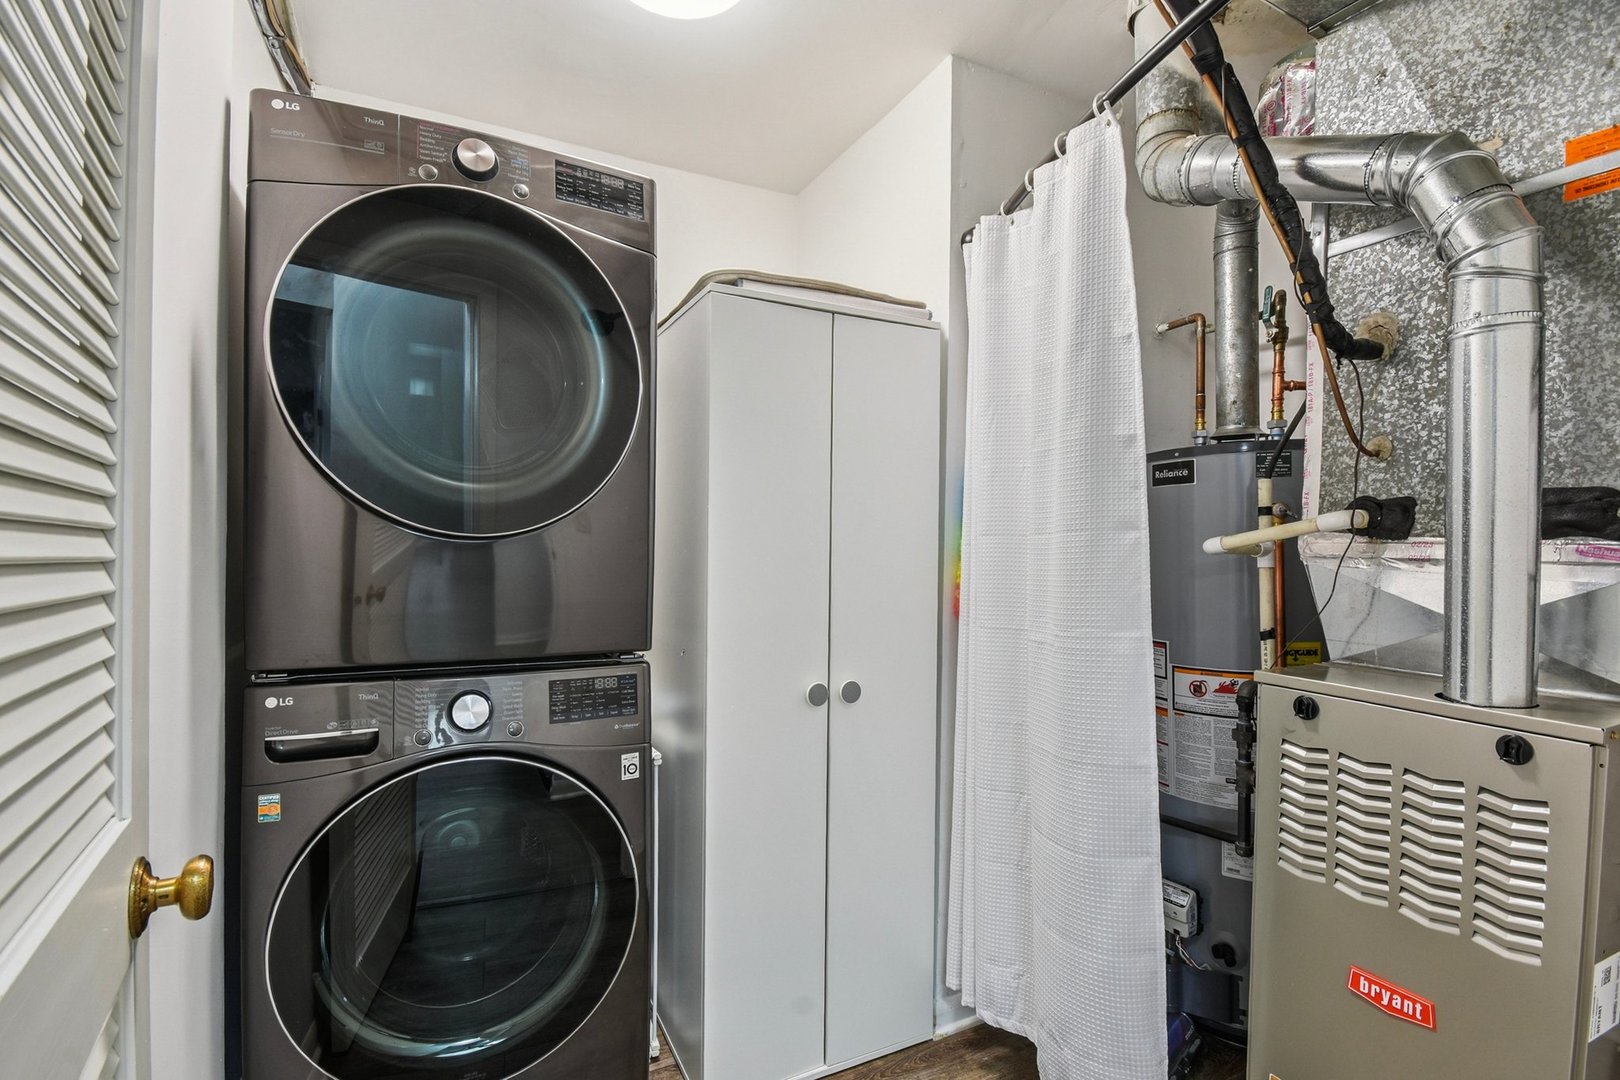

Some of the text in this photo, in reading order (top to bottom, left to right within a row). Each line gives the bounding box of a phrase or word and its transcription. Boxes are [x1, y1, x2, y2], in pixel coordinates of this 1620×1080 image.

[285, 101, 300, 111] LG
[363, 116, 385, 126] ThinQ
[1154, 468, 1189, 479] Reliance
[279, 697, 294, 706] LG
[1360, 976, 1423, 1020] bryant
